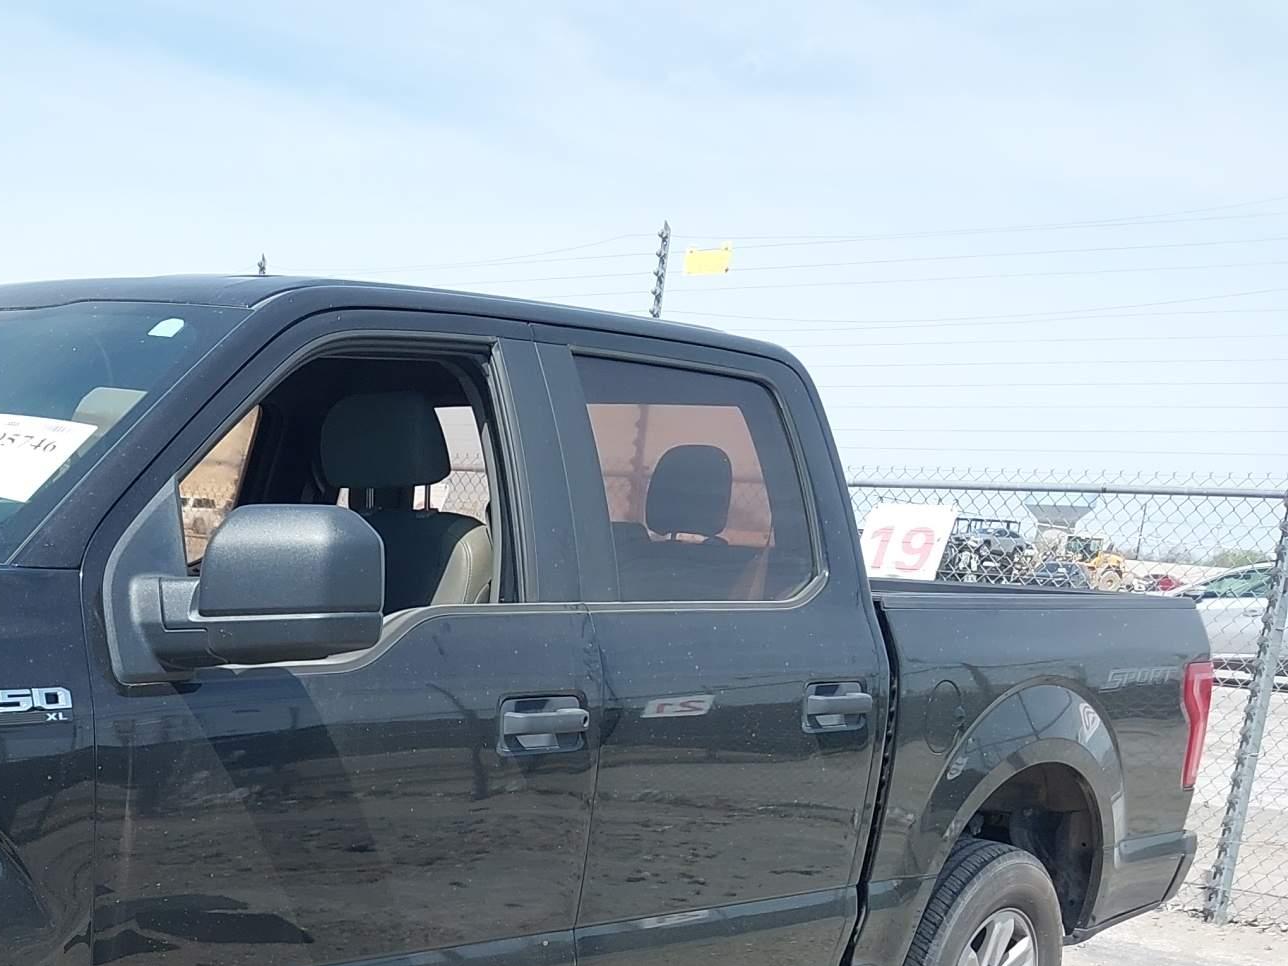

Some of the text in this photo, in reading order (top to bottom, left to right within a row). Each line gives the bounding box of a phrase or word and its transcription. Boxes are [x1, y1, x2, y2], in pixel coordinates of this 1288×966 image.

[869, 525, 936, 572] 19
[1098, 666, 1178, 694] SPORT
[45, 712, 69, 722] XL
